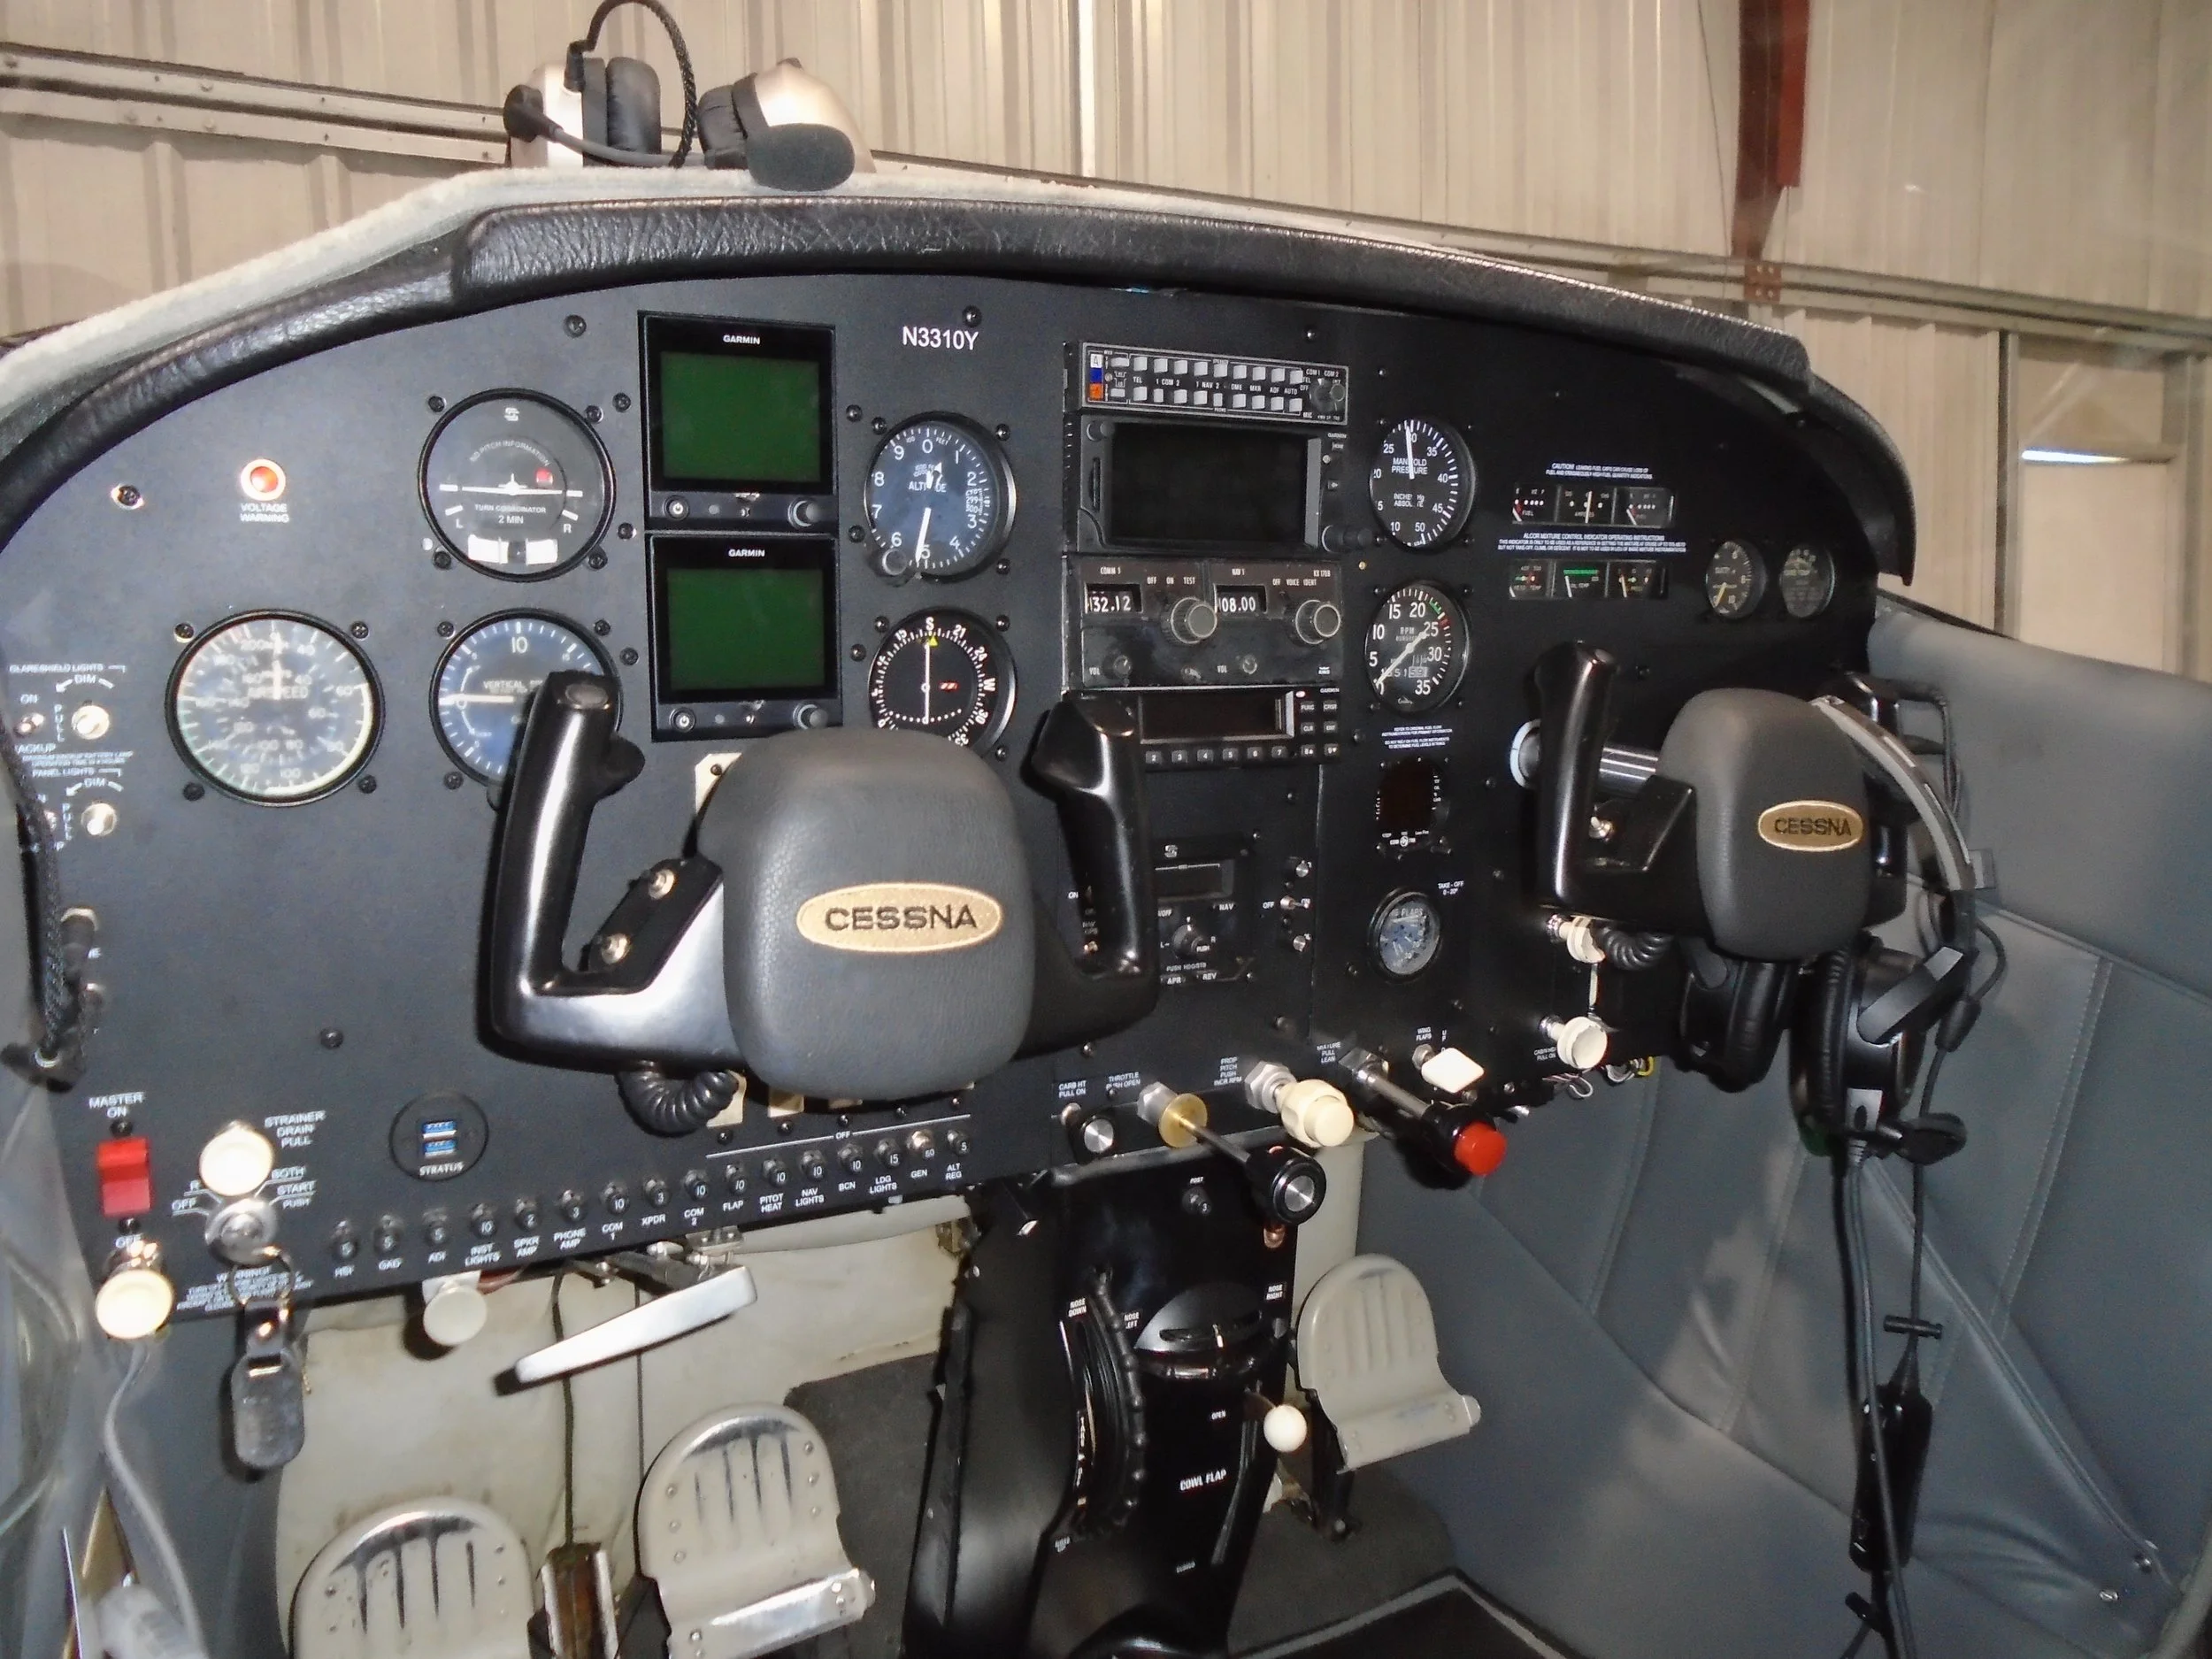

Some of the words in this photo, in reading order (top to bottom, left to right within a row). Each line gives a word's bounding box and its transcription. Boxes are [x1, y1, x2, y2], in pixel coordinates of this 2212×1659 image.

[723, 334, 761, 345] GARMIN
[902, 326, 979, 350] N3310Y
[922, 439, 933, 453] 0
[1384, 444, 1394, 453] 25
[480, 441, 502, 457] PITCH
[503, 441, 550, 466] INFORMATION
[894, 445, 904, 460] 9
[1427, 447, 1437, 457] 35
[874, 472, 885, 487] 8
[967, 472, 977, 486] 2
[1438, 473, 1448, 483] 40
[240, 503, 287, 512] VOLTAGE
[872, 504, 882, 518] 7
[1432, 503, 1443, 513] 45
[240, 513, 289, 523] WARNING
[456, 518, 464, 528] L
[968, 514, 977, 528] 3
[564, 524, 572, 534] R
[1390, 522, 1400, 531] 10
[1416, 522, 1425, 532] 50
[891, 532, 902, 547] 6
[949, 535, 960, 550] 4
[1389, 604, 1401, 618] 15
[1409, 603, 1425, 618] 20
[926, 617, 934, 630] S
[1423, 621, 1438, 636] 25
[953, 625, 966, 637] 21
[1373, 624, 1385, 640] 10
[511, 636, 528, 654] 10
[974, 646, 987, 661] 24
[1369, 651, 1377, 667] 5
[1427, 647, 1441, 661] 30
[74, 674, 96, 683] DIM
[984, 678, 995, 691] W
[1415, 680, 1431, 695] 35
[20, 694, 38, 703] ON
[975, 709, 988, 725] 30
[32, 769, 59, 778] PANEL
[63, 767, 94, 776] LIGHTS
[84, 779, 105, 787] DIM
[1774, 818, 1851, 836] CESSNA
[825, 904, 977, 931] CESSNA
[1109, 1072, 1139, 1082] THROTTLE
[1214, 1078, 1228, 1087] INCR
[1059, 1081, 1076, 1091] CARB
[1059, 1089, 1075, 1098] PULL
[88, 1092, 144, 1109] MASTER
[107, 1107, 127, 1118] ON
[265, 1110, 326, 1128] STRAINER
[277, 1124, 315, 1137] DRAIN
[281, 1136, 312, 1148] PULL
[961, 1142, 967, 1151] 5
[890, 1154, 899, 1164] 15
[419, 1162, 464, 1175] STRATUS
[813, 1166, 822, 1177] 10
[852, 1161, 861, 1171] 10
[948, 1163, 960, 1171] ALT
[272, 1166, 306, 1179] BOTH
[777, 1171, 786, 1182] 10
[910, 1170, 928, 1179] GEN
[945, 1171, 962, 1180] REG
[736, 1180, 744, 1191] 10
[875, 1175, 891, 1186] LDG
[277, 1180, 316, 1194] START
[696, 1186, 705, 1196] 10
[839, 1181, 856, 1192] BCN
[870, 1181, 897, 1194] LIGHTS
[658, 1193, 664, 1203] 3
[803, 1187, 818, 1198] NAV
[172, 1198, 197, 1211] OFF
[282, 1197, 311, 1209] PUSH
[614, 1200, 625, 1210] 10
[759, 1194, 784, 1205] PITOT
[795, 1194, 825, 1208] LIGHTS
[723, 1201, 743, 1211] FLAP
[761, 1202, 782, 1213] HEAT
[572, 1207, 580, 1218] 3
[684, 1208, 704, 1219] COM
[528, 1214, 534, 1225] 2
[641, 1213, 665, 1226] XPDR
[480, 1222, 492, 1233] 10
[603, 1222, 623, 1233] COM
[434, 1229, 442, 1240] 5
[554, 1228, 586, 1241] PHONE
[384, 1236, 392, 1248] 5
[514, 1236, 540, 1249] SPKR
[560, 1238, 580, 1250] AMP
[471, 1243, 494, 1256] INST
[517, 1246, 537, 1258] AMP
[428, 1251, 447, 1263] ADI
[465, 1251, 500, 1266] LIGHTS
[379, 1258, 403, 1270] GAD
[334, 1265, 354, 1278] HSI
[1268, 1284, 1282, 1293] NOSE
[1266, 1291, 1283, 1301] RIGHT
[1071, 1298, 1086, 1309] NOSE
[1068, 1305, 1087, 1317] DOWN
[1124, 1312, 1139, 1321] NOSE
[1211, 1410, 1226, 1420] OPEN
[1180, 1475, 1202, 1491] COWL
[1205, 1470, 1226, 1484] FLAP
